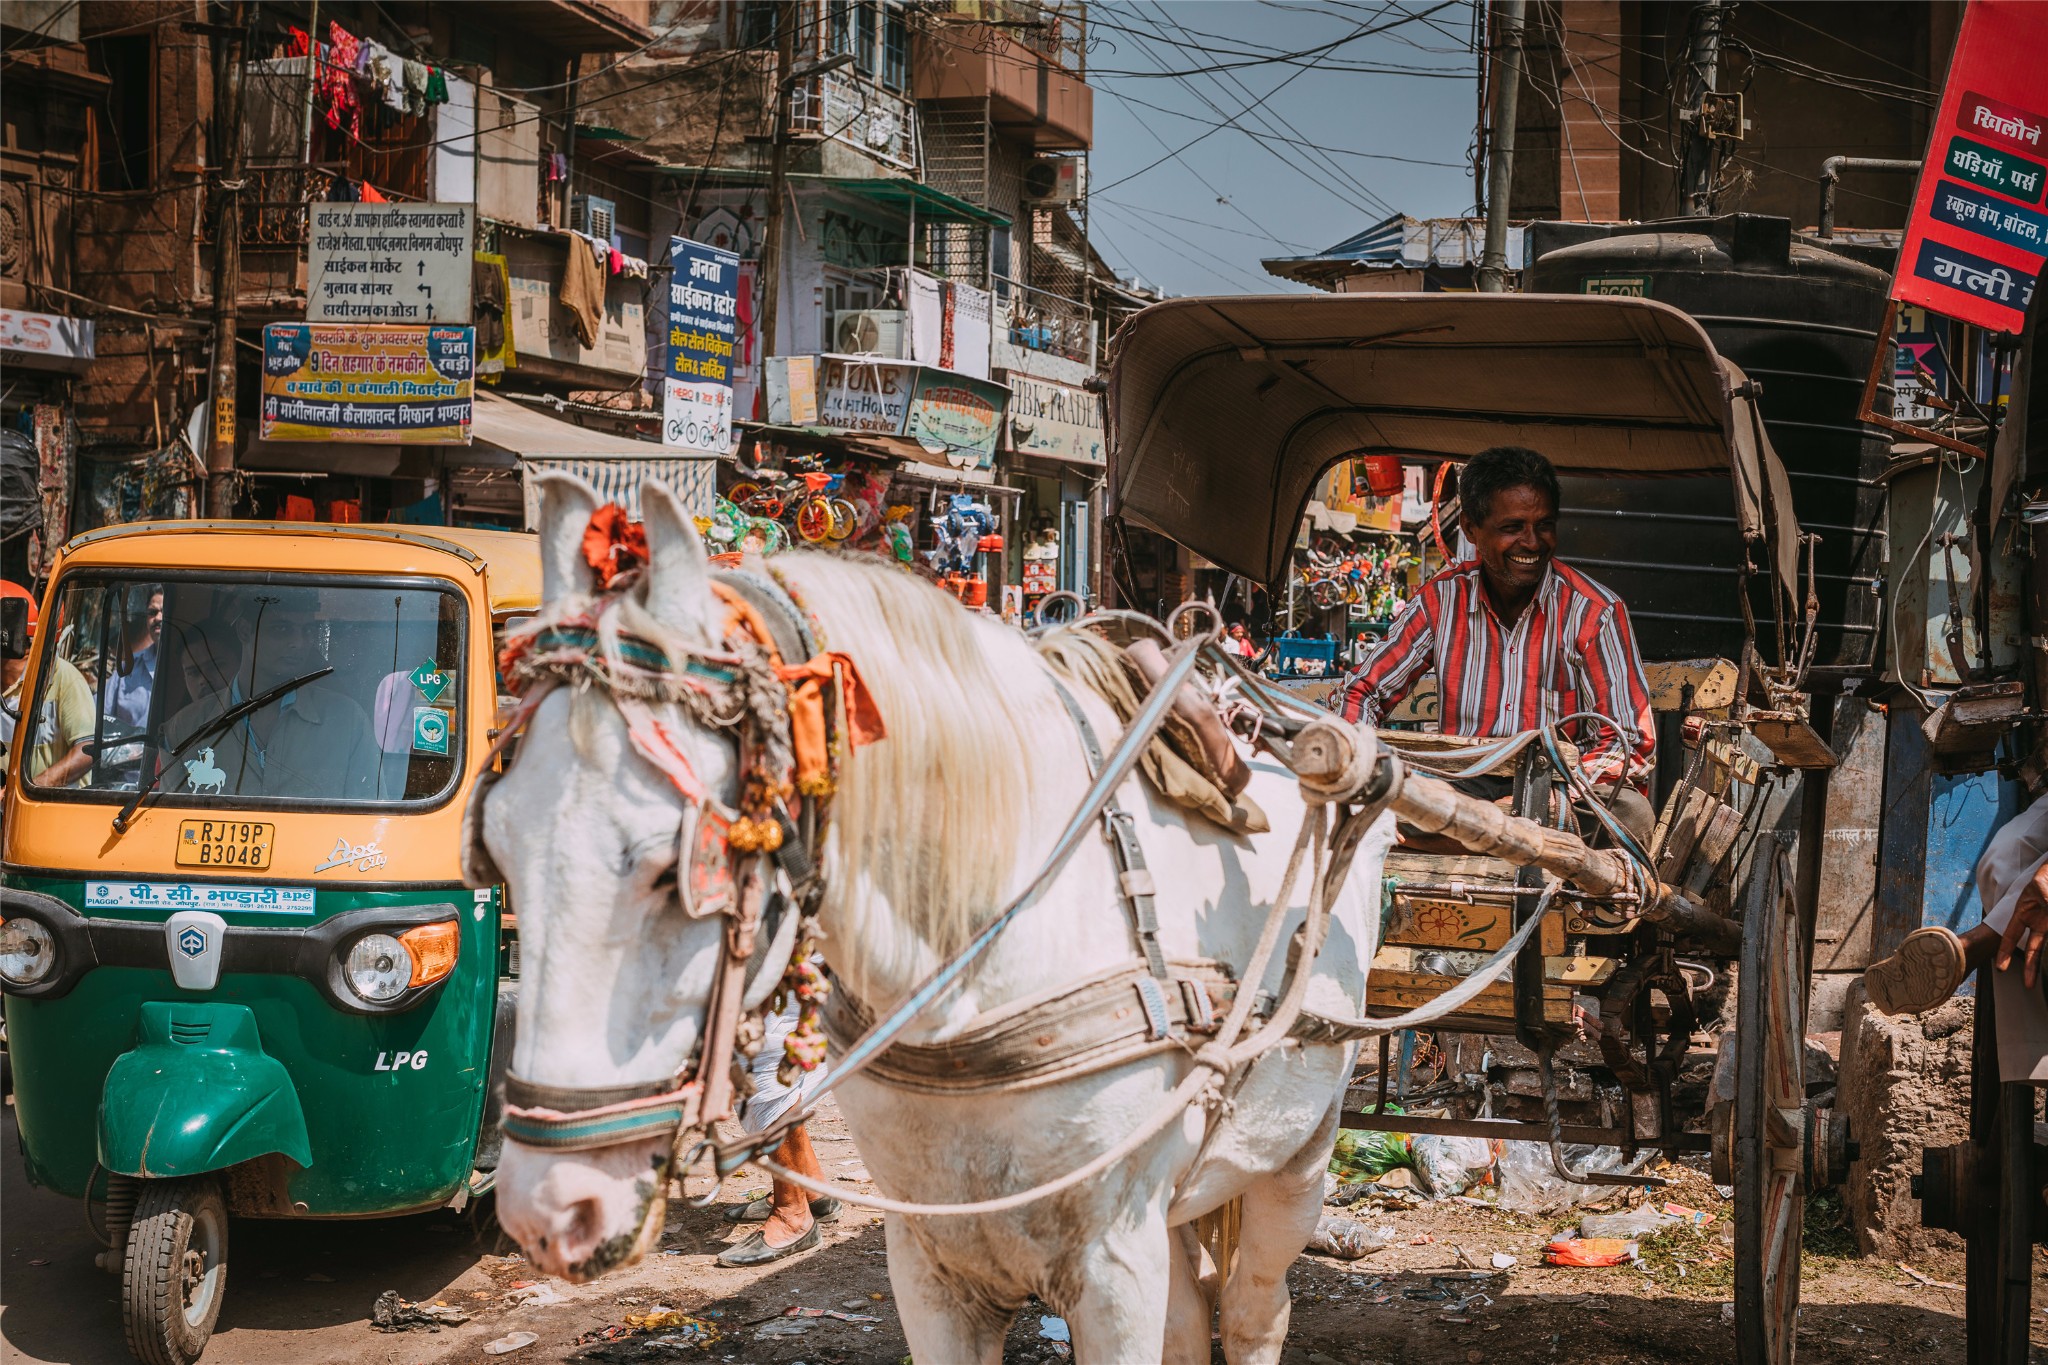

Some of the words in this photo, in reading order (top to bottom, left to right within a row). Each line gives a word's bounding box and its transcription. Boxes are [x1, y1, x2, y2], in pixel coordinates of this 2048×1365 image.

[1973, 105, 2042, 146] खिलौने
[1953, 149, 2005, 185] घड़ियाँ,
[2010, 169, 2038, 193] पर्स
[354, 212, 381, 229] आपका
[382, 208, 408, 229] हार्दिक
[408, 212, 435, 229] स्वागत
[436, 212, 458, 229] करता
[458, 208, 465, 229] है
[1946, 194, 1978, 221] स्कूल
[317, 232, 341, 251] राजेश
[408, 232, 433, 251] निगम
[433, 232, 464, 257] जोधपुर
[324, 257, 367, 274] साईकल
[370, 257, 402, 273] मार्केट
[690, 256, 722, 284] जनता
[360, 282, 393, 296] सागर
[1933, 256, 2015, 301] गली
[671, 281, 713, 310] साईकल
[713, 290, 736, 317] स्टोर
[314, 328, 346, 344] नवरात्रि
[348, 328, 358, 344] के
[361, 332, 377, 350] शुभ
[379, 332, 409, 345] अवसर
[411, 332, 424, 345] पर
[670, 325, 688, 347] होल
[688, 329, 705, 351] सेल
[705, 333, 733, 357] विक्रेता
[311, 351, 319, 372] 9
[322, 350, 340, 373] दिन
[376, 350, 386, 373] के
[388, 351, 427, 374] नमकीन
[675, 352, 693, 374] सेल
[700, 358, 727, 380] सर्विस
[325, 379, 342, 394] की
[265, 398, 278, 417] श्री
[280, 400, 340, 423] मांगीलालजी
[342, 402, 396, 425] कैलाशचन्द
[399, 404, 434, 424] मिष्ठान
[437, 403, 471, 422] भण्डार
[420, 673, 441, 685] LPG
[201, 822, 263, 844] RJ19P
[200, 844, 262, 865] B3048
[314, 837, 383, 873] Ape
[358, 854, 387, 872] City
[129, 883, 159, 900] पी.
[166, 884, 200, 901] सी.
[207, 887, 279, 904] भण्डारी
[282, 891, 312, 902] ape
[374, 1050, 428, 1070] LPG
